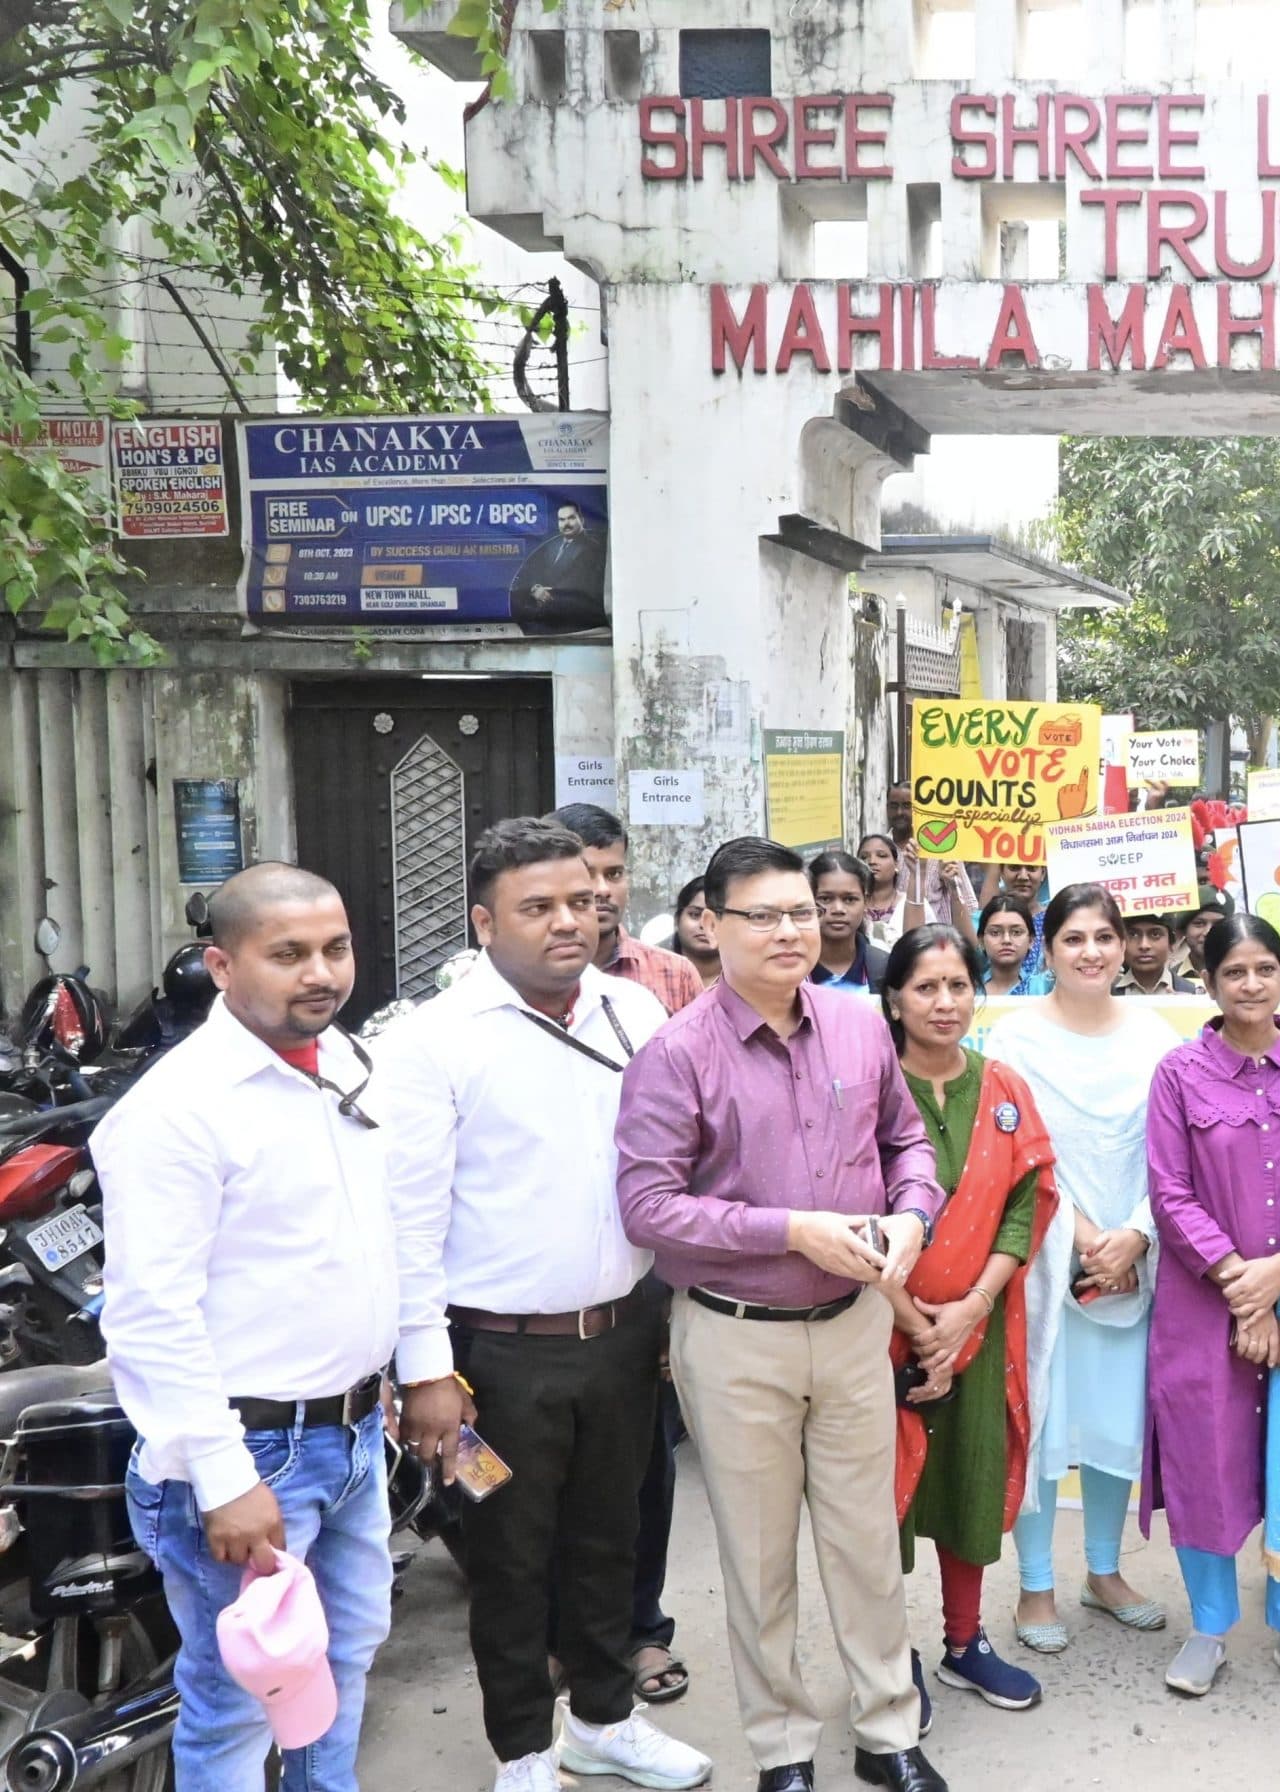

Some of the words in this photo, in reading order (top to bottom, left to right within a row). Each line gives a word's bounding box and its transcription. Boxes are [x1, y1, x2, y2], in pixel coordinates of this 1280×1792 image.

[639, 93, 894, 182] SHREE
[951, 92, 1206, 182] SHREE
[710, 283, 1041, 374] MAHILA
[119, 426, 216, 448] ENGLISH
[274, 425, 485, 454] CHANAKYA
[121, 449, 171, 466] HON'S
[177, 448, 189, 464] &
[194, 447, 216, 463] PG
[300, 456, 336, 473] IAS
[349, 454, 463, 473] ACADEMY
[121, 478, 167, 491] SPOKEN
[169, 476, 220, 489] ENGLISH
[174, 491, 208, 501] Maharaj
[269, 502, 309, 518] FREE
[341, 511, 358, 523] ON
[366, 505, 412, 527] UPSC
[429, 504, 471, 525] JPSC
[489, 503, 537, 525] BPSC
[270, 518, 336, 534] SEMINAR
[370, 547, 382, 557] BY
[385, 546, 431, 557] SUCCESS
[365, 591, 382, 600] NEW
[384, 590, 407, 600] TOWN
[920, 707, 1039, 748] EVERY
[1043, 733, 1072, 743] VOTE
[1128, 738, 1153, 749] Your
[1156, 737, 1182, 748] Vote
[577, 760, 603, 771] Girls
[975, 748, 1068, 783] VOTE
[1130, 755, 1156, 768] Your
[1160, 753, 1197, 767] Choice
[567, 775, 615, 787] Entrance
[653, 775, 679, 787] Girls
[641, 792, 692, 803] Entrance
[914, 775, 1037, 808] COUNTS
[1048, 824, 1083, 836] VIDHAN
[1086, 820, 1117, 832] SABHA
[1119, 815, 1163, 829] ELECTION
[1165, 811, 1187, 823] 2024
[1161, 830, 1178, 840] 2024
[972, 825, 1048, 863] YOU
[1142, 872, 1177, 888] मत
[1131, 892, 1192, 911] ताकत
[56, 1226, 96, 1259] 8547
